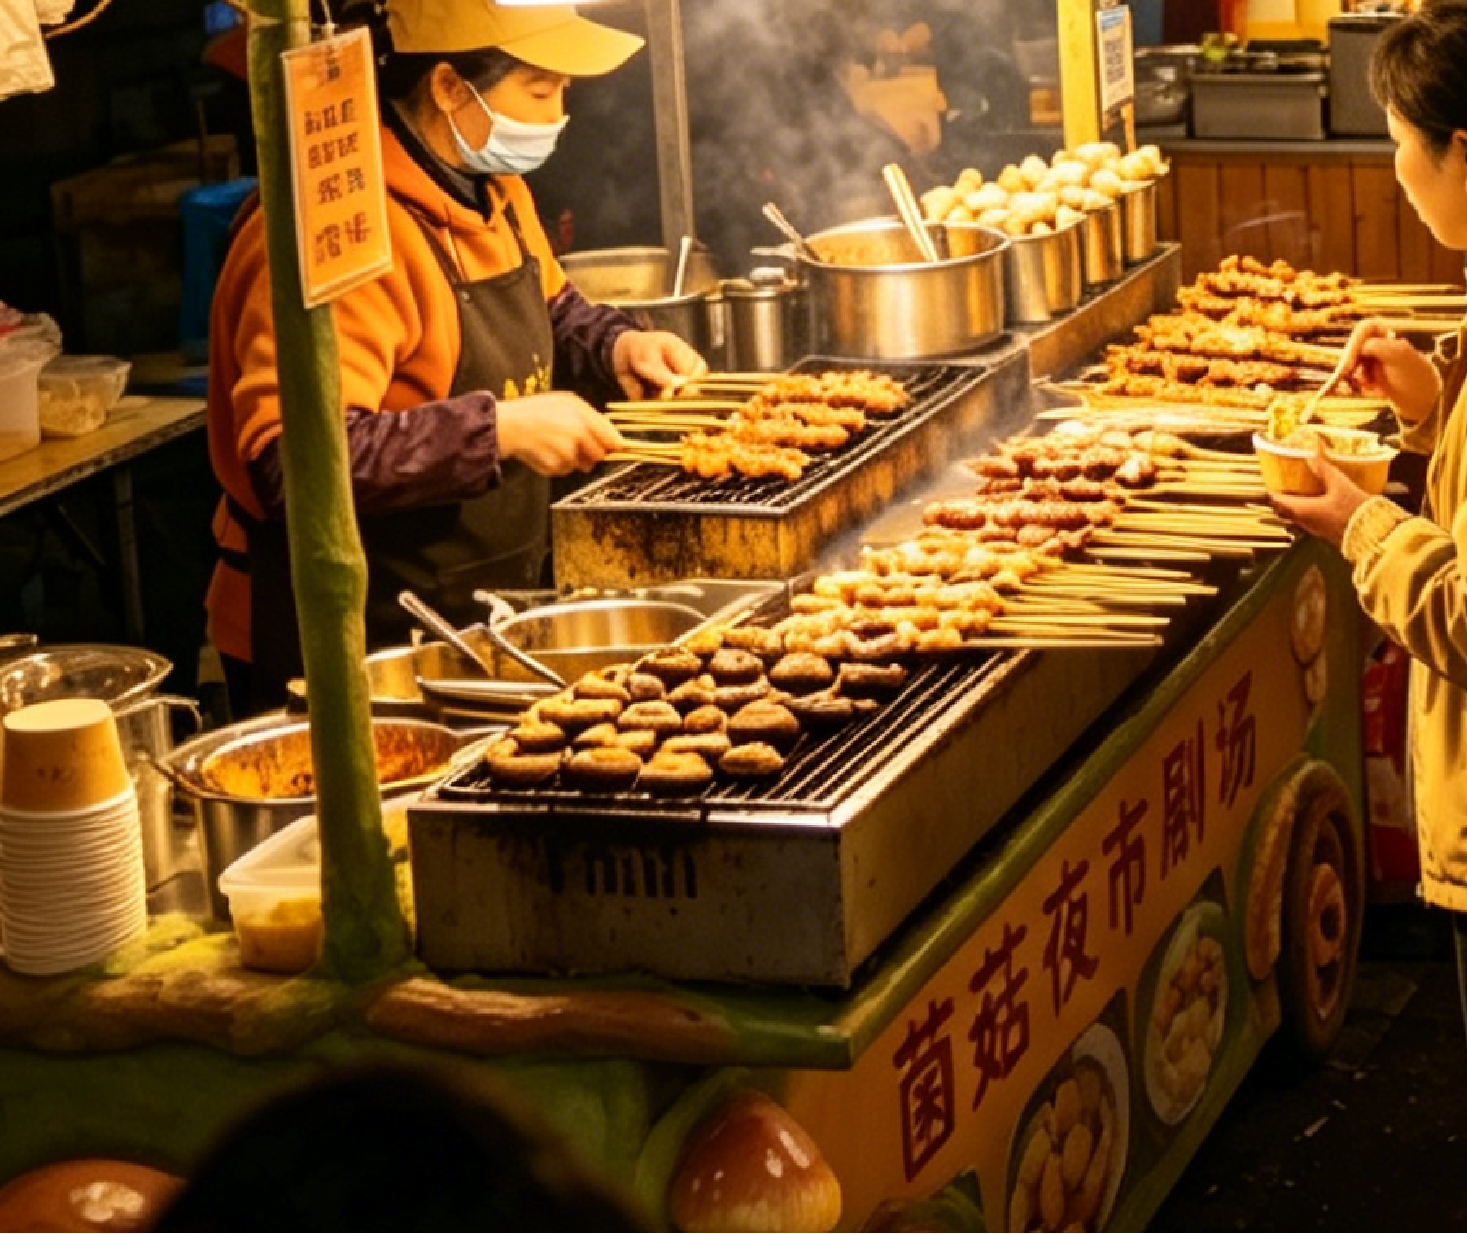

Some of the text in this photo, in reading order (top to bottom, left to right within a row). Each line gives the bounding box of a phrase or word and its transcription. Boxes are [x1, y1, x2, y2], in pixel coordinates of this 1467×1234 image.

[892, 669, 1257, 1184] 菌菇夜市剧场
